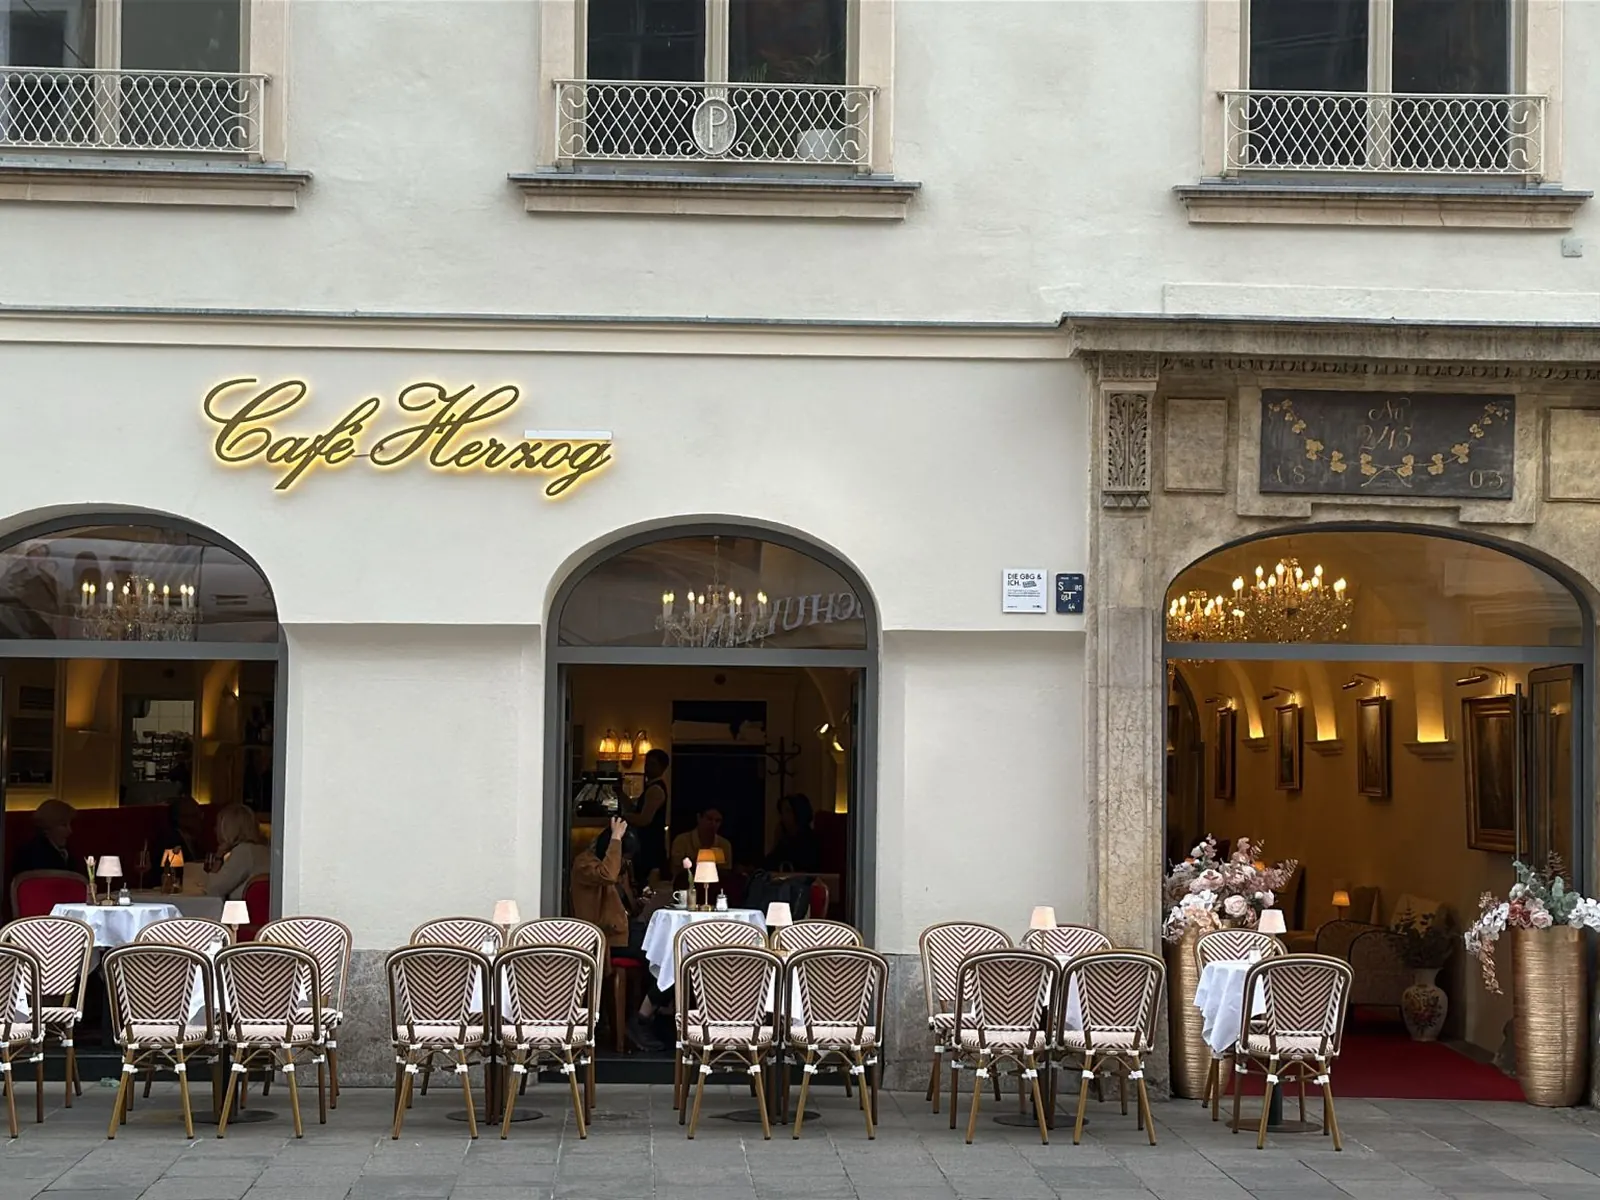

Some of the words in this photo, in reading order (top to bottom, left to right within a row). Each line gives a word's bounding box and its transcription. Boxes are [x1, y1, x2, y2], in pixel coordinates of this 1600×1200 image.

[708, 105, 728, 149] P
[203, 377, 381, 490] Café
[369, 381, 612, 496] Herzog
